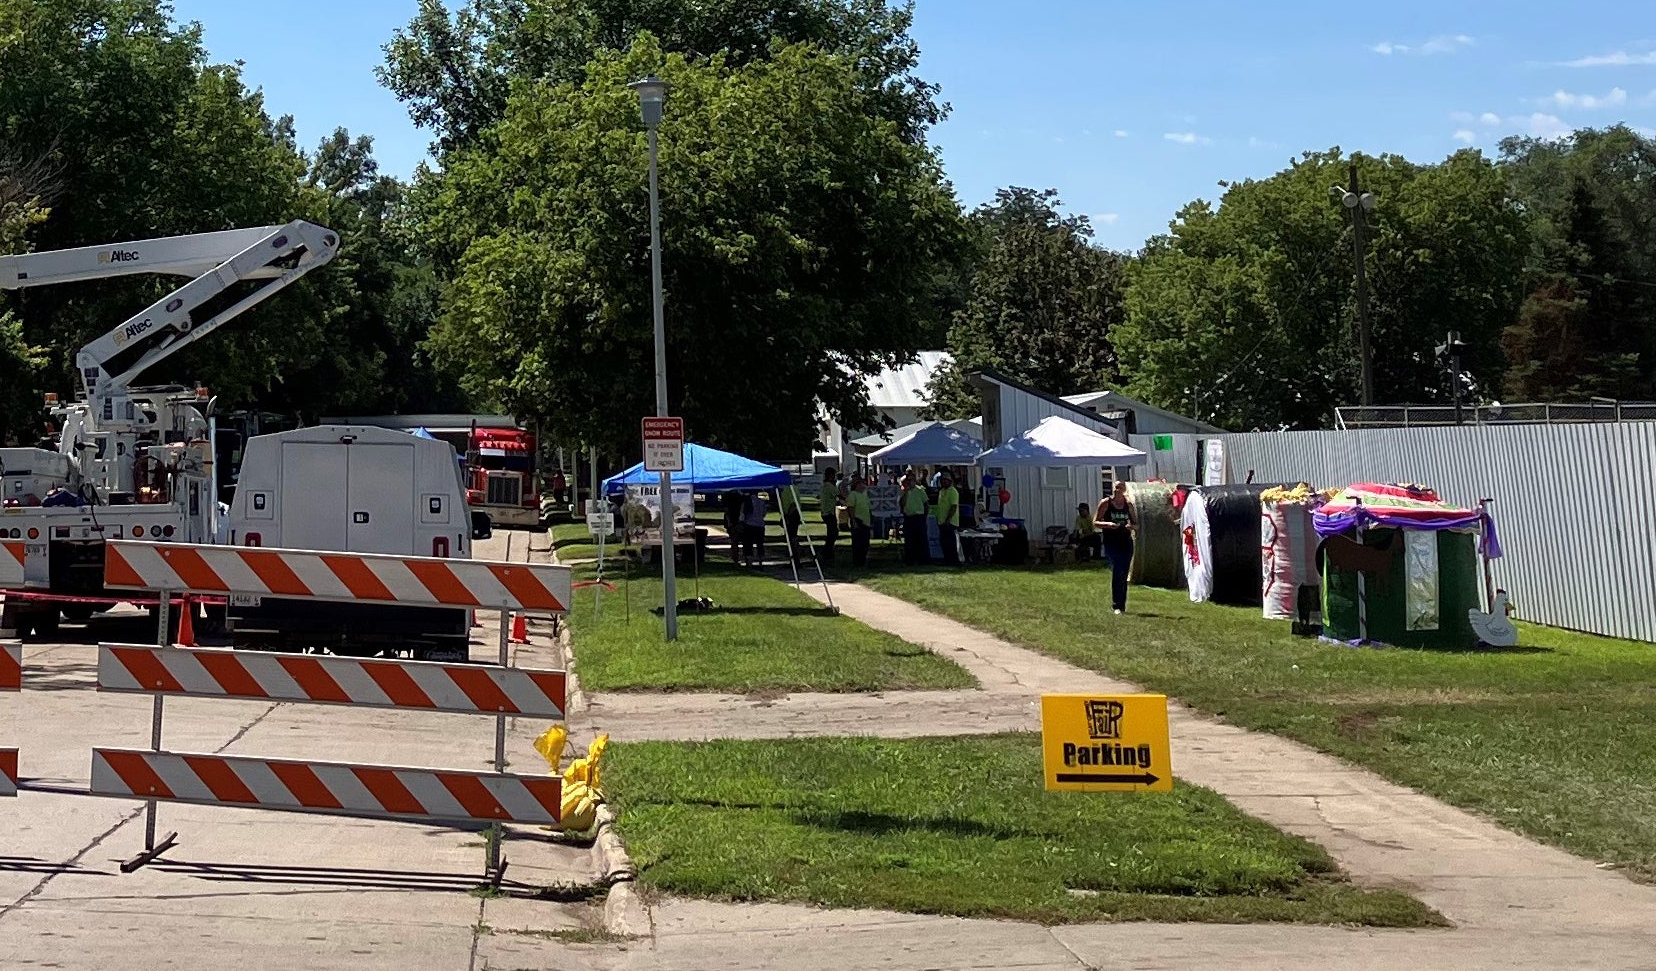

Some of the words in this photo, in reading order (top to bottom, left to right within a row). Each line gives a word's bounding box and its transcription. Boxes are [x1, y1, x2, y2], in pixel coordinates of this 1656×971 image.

[110, 250, 139, 263] Altec
[125, 318, 152, 340] Altec
[1063, 742, 1151, 769] Parking
